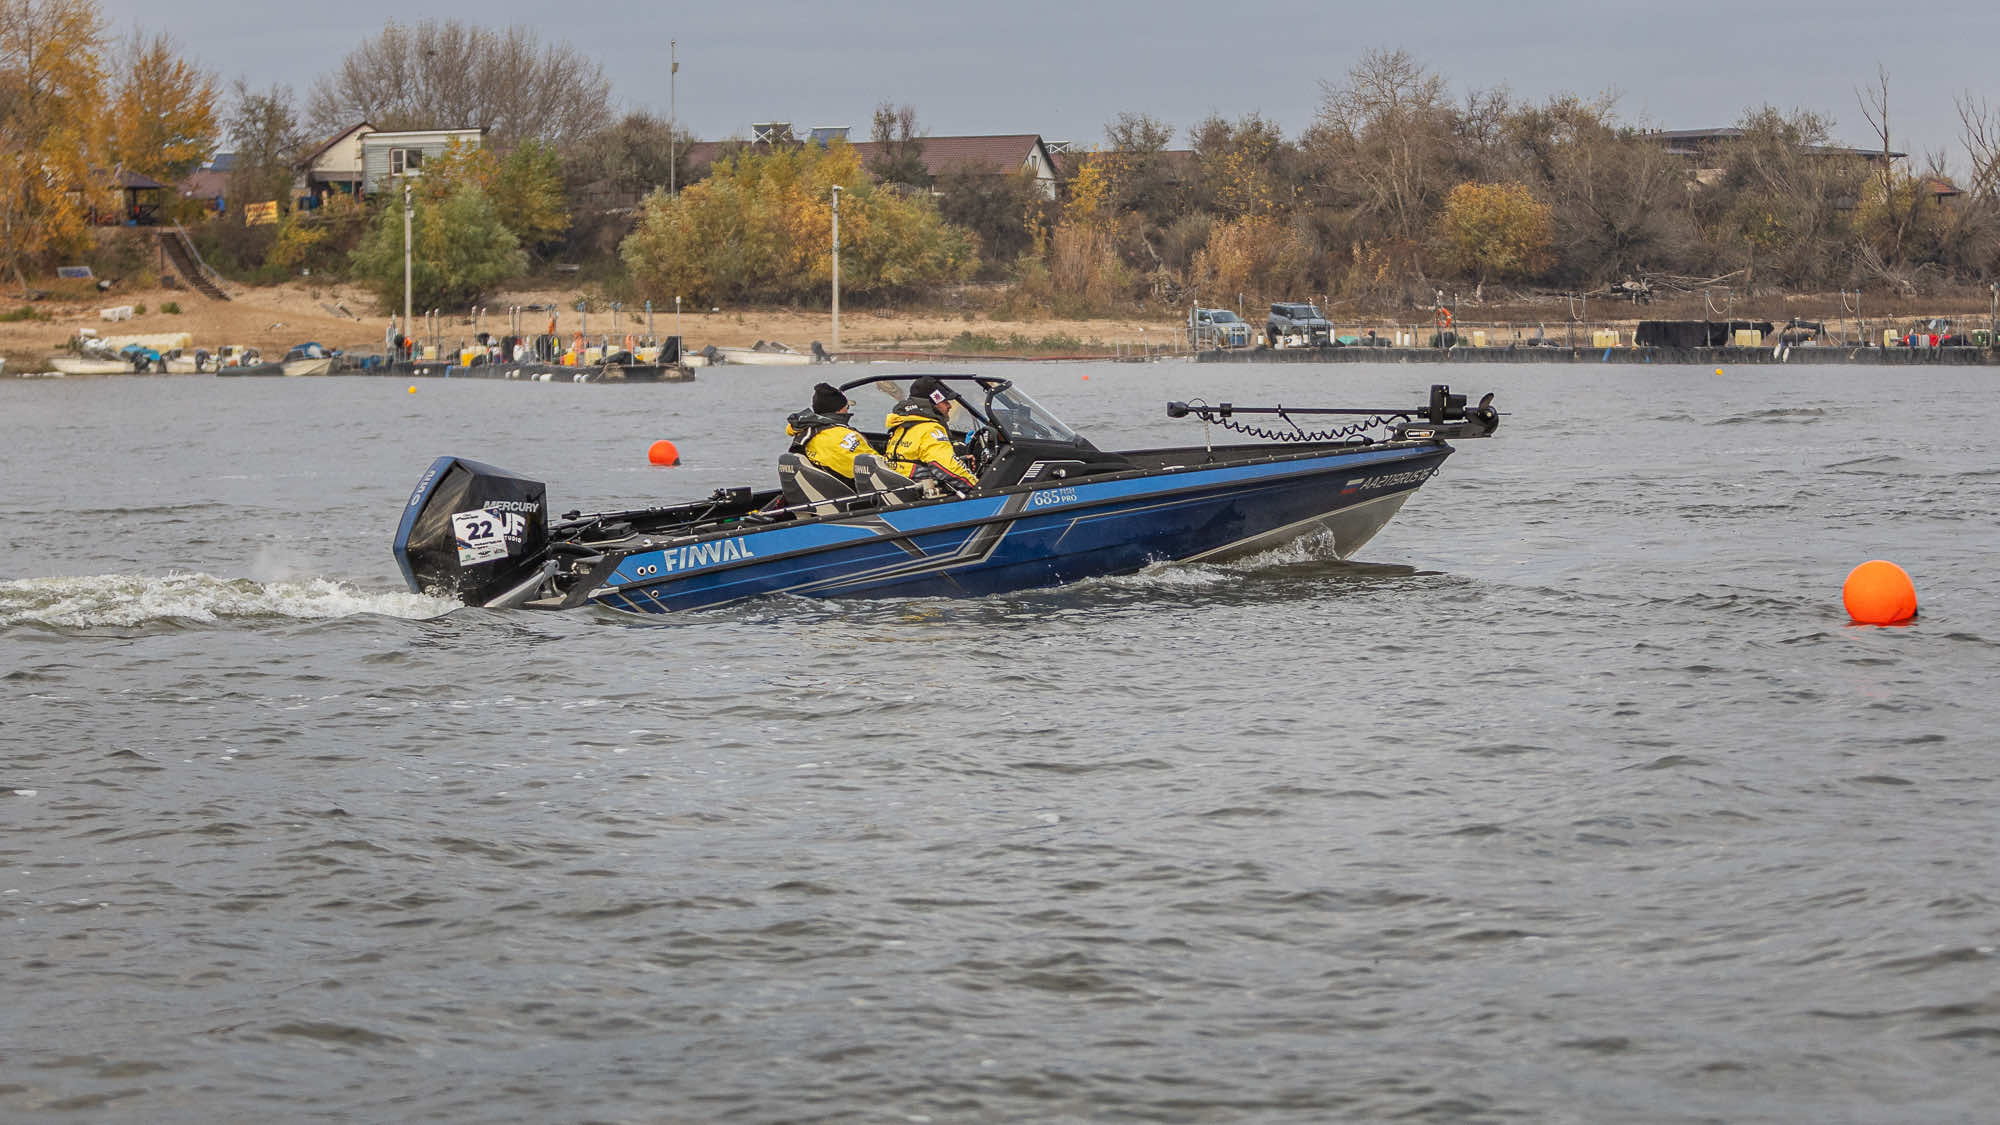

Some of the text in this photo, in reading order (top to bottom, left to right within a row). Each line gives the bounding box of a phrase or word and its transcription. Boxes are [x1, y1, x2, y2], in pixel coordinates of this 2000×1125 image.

[484, 501, 539, 512] MERCURY
[1034, 490, 1060, 506] 685
[466, 521, 494, 540] 22
[664, 538, 754, 572] FINVAL
